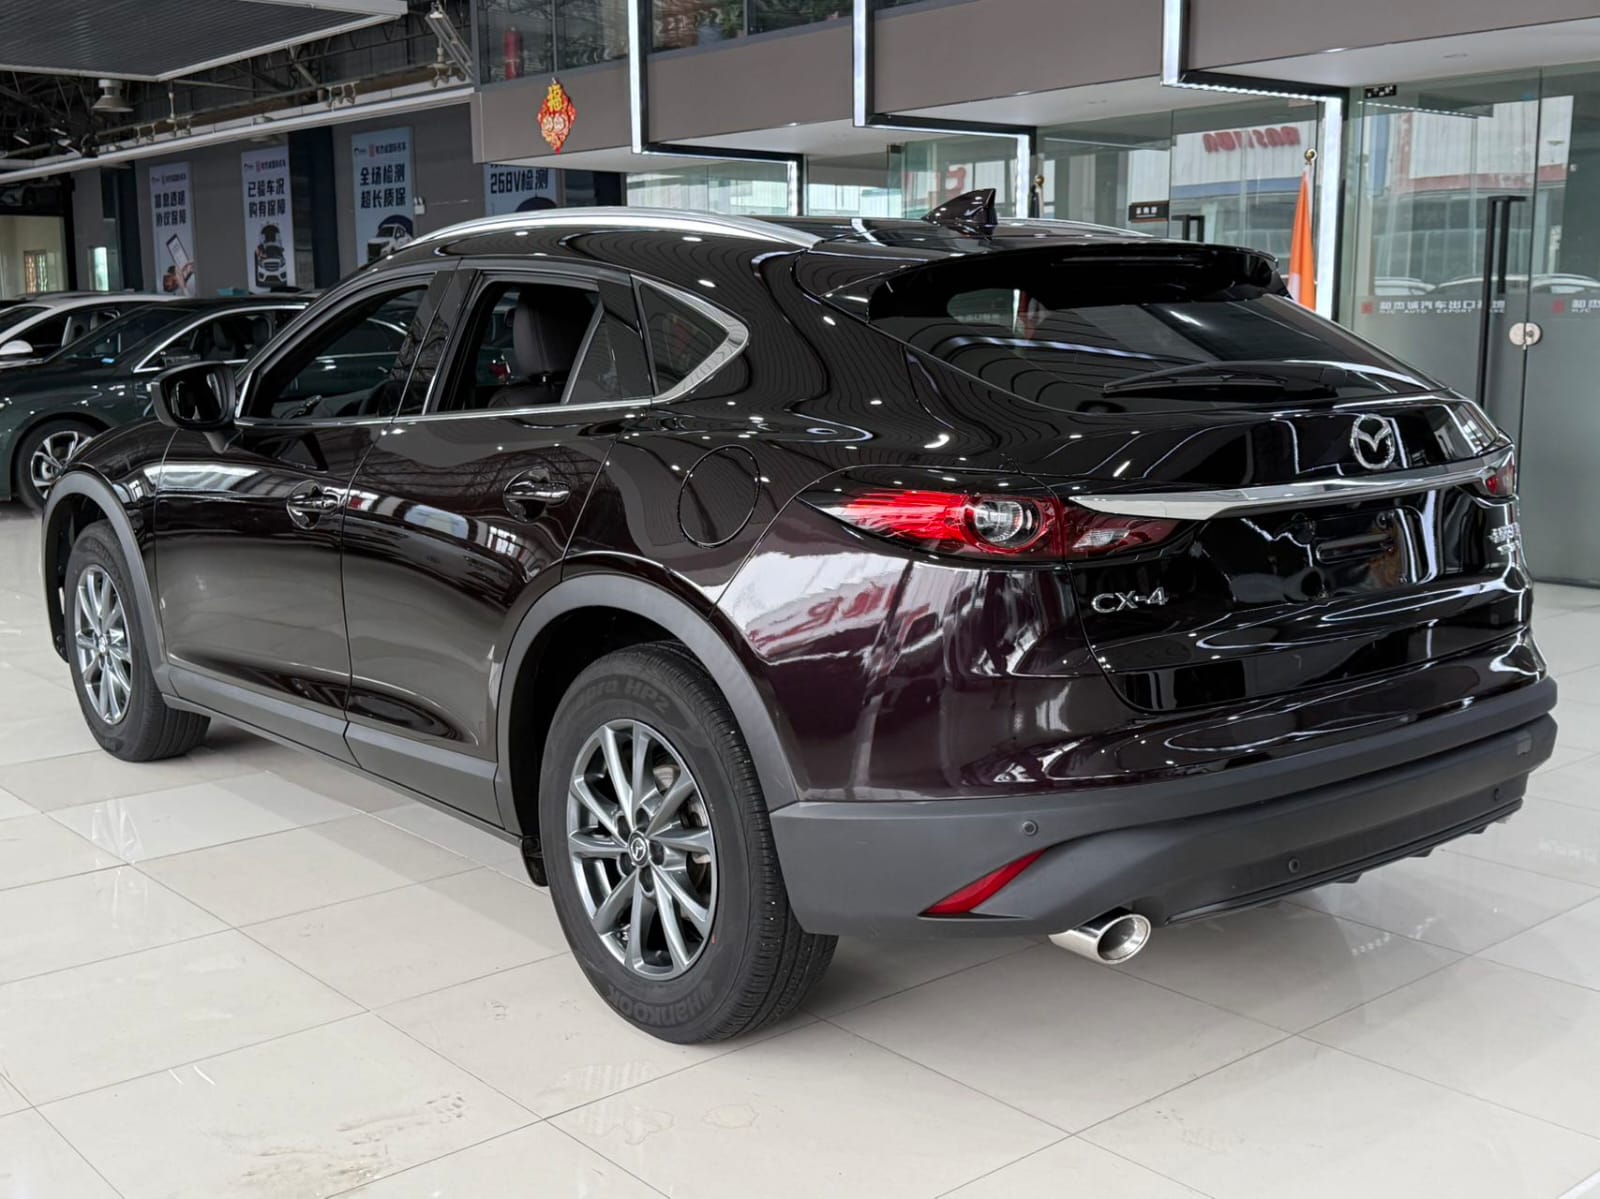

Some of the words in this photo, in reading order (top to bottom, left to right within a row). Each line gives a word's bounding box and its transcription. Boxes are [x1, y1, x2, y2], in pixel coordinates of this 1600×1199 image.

[360, 163, 406, 186] 全场检测
[248, 177, 285, 198] 已验车况
[360, 186, 406, 209] 超长质保
[248, 199, 286, 218] 购有保障
[1091, 586, 1169, 614] CX-4
